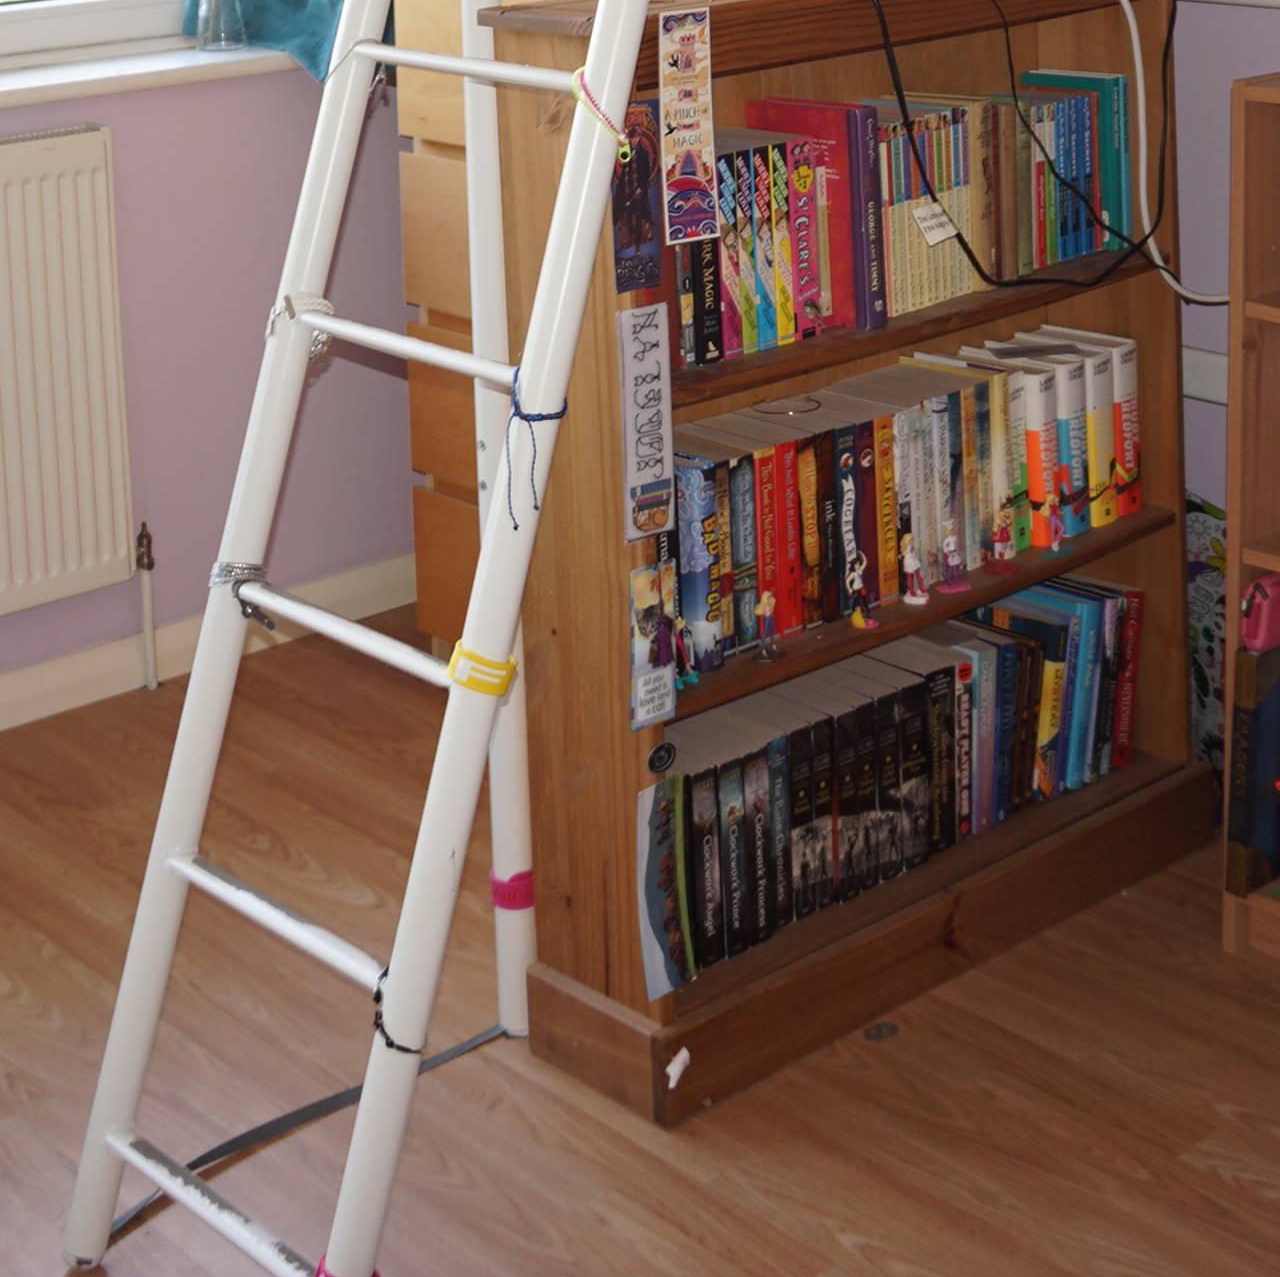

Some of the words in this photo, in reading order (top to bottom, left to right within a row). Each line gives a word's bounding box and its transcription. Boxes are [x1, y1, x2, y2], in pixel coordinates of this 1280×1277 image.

[674, 108, 700, 120] PINCH
[672, 134, 704, 148] MAGIC
[868, 201, 877, 241] GEORGE
[704, 267, 714, 309] MAGIC
[870, 261, 878, 292] TIMMY
[1070, 420, 1081, 486] REDFORT
[1122, 403, 1134, 470] REDFORT
[761, 463, 773, 482] This
[1040, 431, 1055, 494] REDFOR
[762, 484, 773, 504] Book
[825, 500, 836, 523] ink
[704, 515, 718, 555] BAD
[844, 488, 856, 565] COGHEAR
[765, 563, 775, 580] You
[707, 563, 720, 623] MAGIC
[639, 695, 656, 708] love
[959, 692, 971, 735] READY
[1118, 683, 1133, 746] NEVERWHERE
[960, 738, 970, 785] PLAYER
[774, 776, 783, 797] The
[960, 788, 970, 816] ONE
[775, 800, 784, 830] Bane
[728, 825, 739, 887] Clockwork
[754, 813, 765, 877] Clockwork
[702, 835, 712, 900] Clockwork
[775, 833, 785, 901] Chronicles
[704, 903, 715, 938] Angel
[731, 891, 741, 928] Prince
[756, 880, 767, 927] Princess
